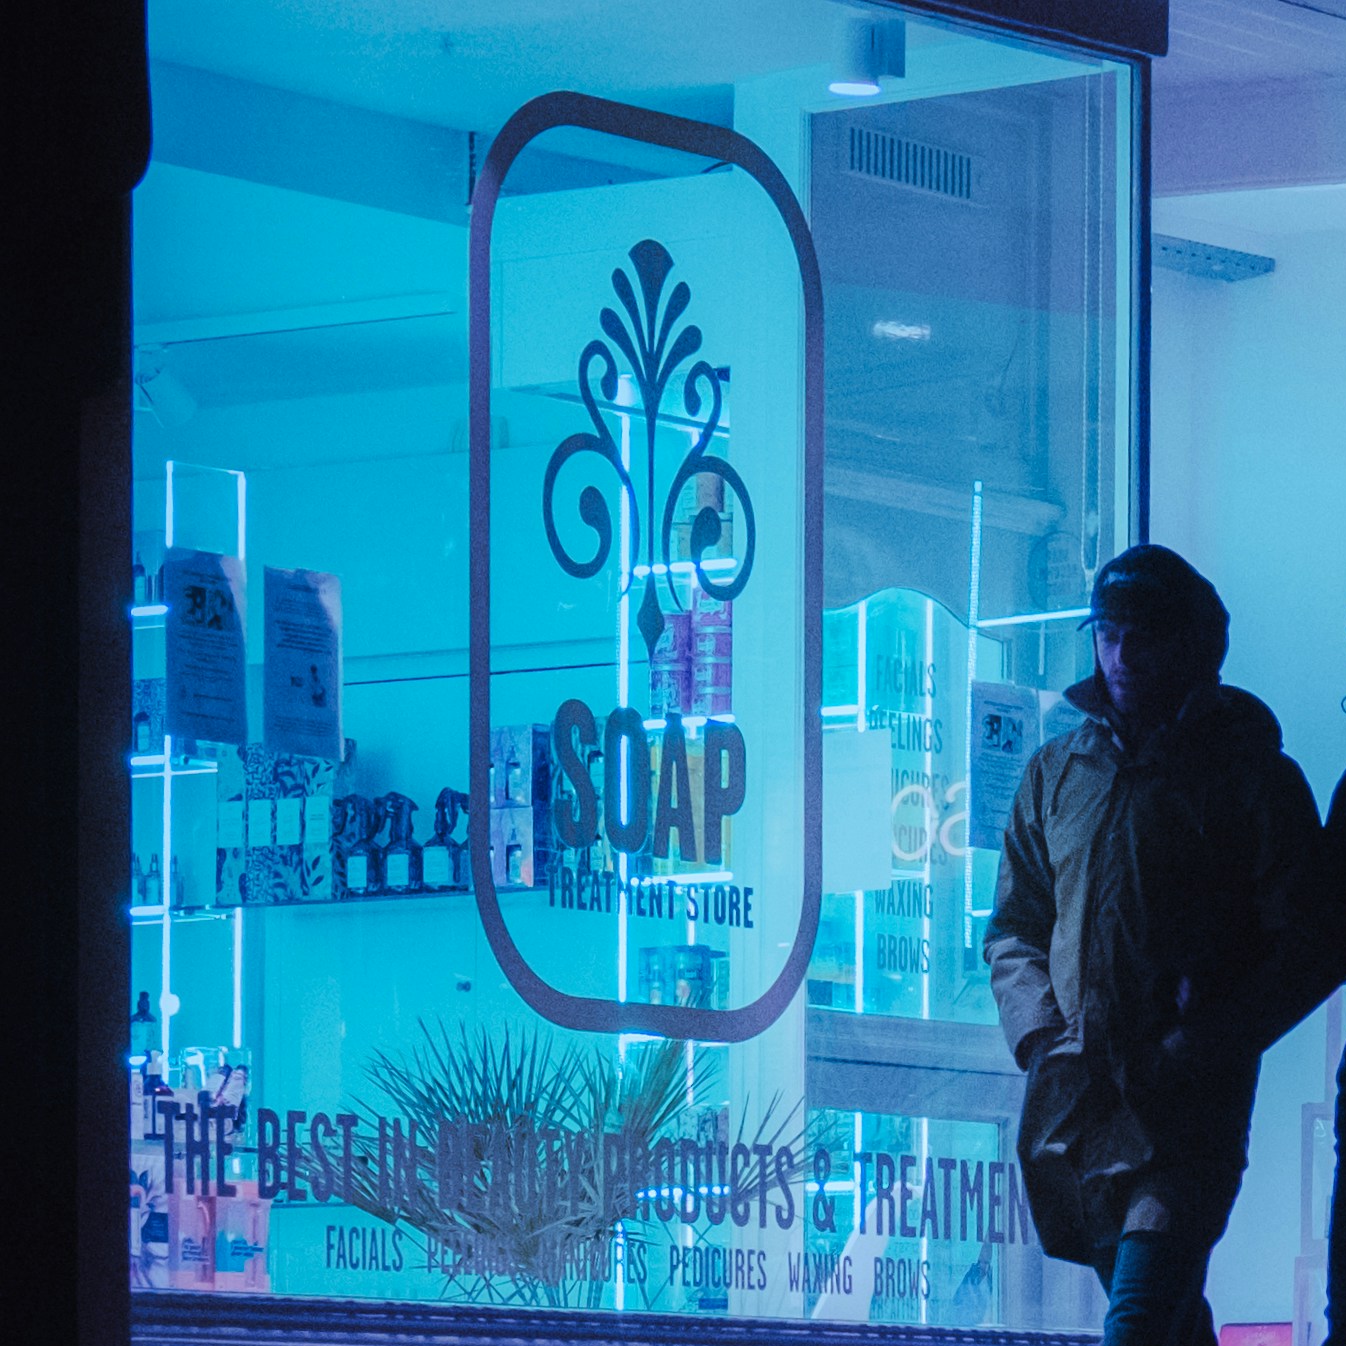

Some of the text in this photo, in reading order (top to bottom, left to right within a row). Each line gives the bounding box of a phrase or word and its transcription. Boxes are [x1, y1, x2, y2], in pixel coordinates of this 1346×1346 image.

[876, 654, 937, 698] FACIALS
[553, 699, 746, 865] SOAP
[547, 864, 754, 929] TREATMENT STORE
[874, 880, 934, 920] WAXING
[876, 933, 931, 974] BROWS
[157, 1100, 237, 1197] THE
[258, 1108, 358, 1204] BEST
[378, 1116, 419, 1211] IN
[603, 1133, 795, 1231] PRODUCTS
[812, 1148, 837, 1233] &
[855, 1152, 1028, 1245] TREATMEN
[326, 1224, 404, 1272] FACIALS
[670, 1245, 767, 1292] PEDICURES
[787, 1252, 853, 1296] WAXING
[874, 1256, 931, 1300] BROWS
